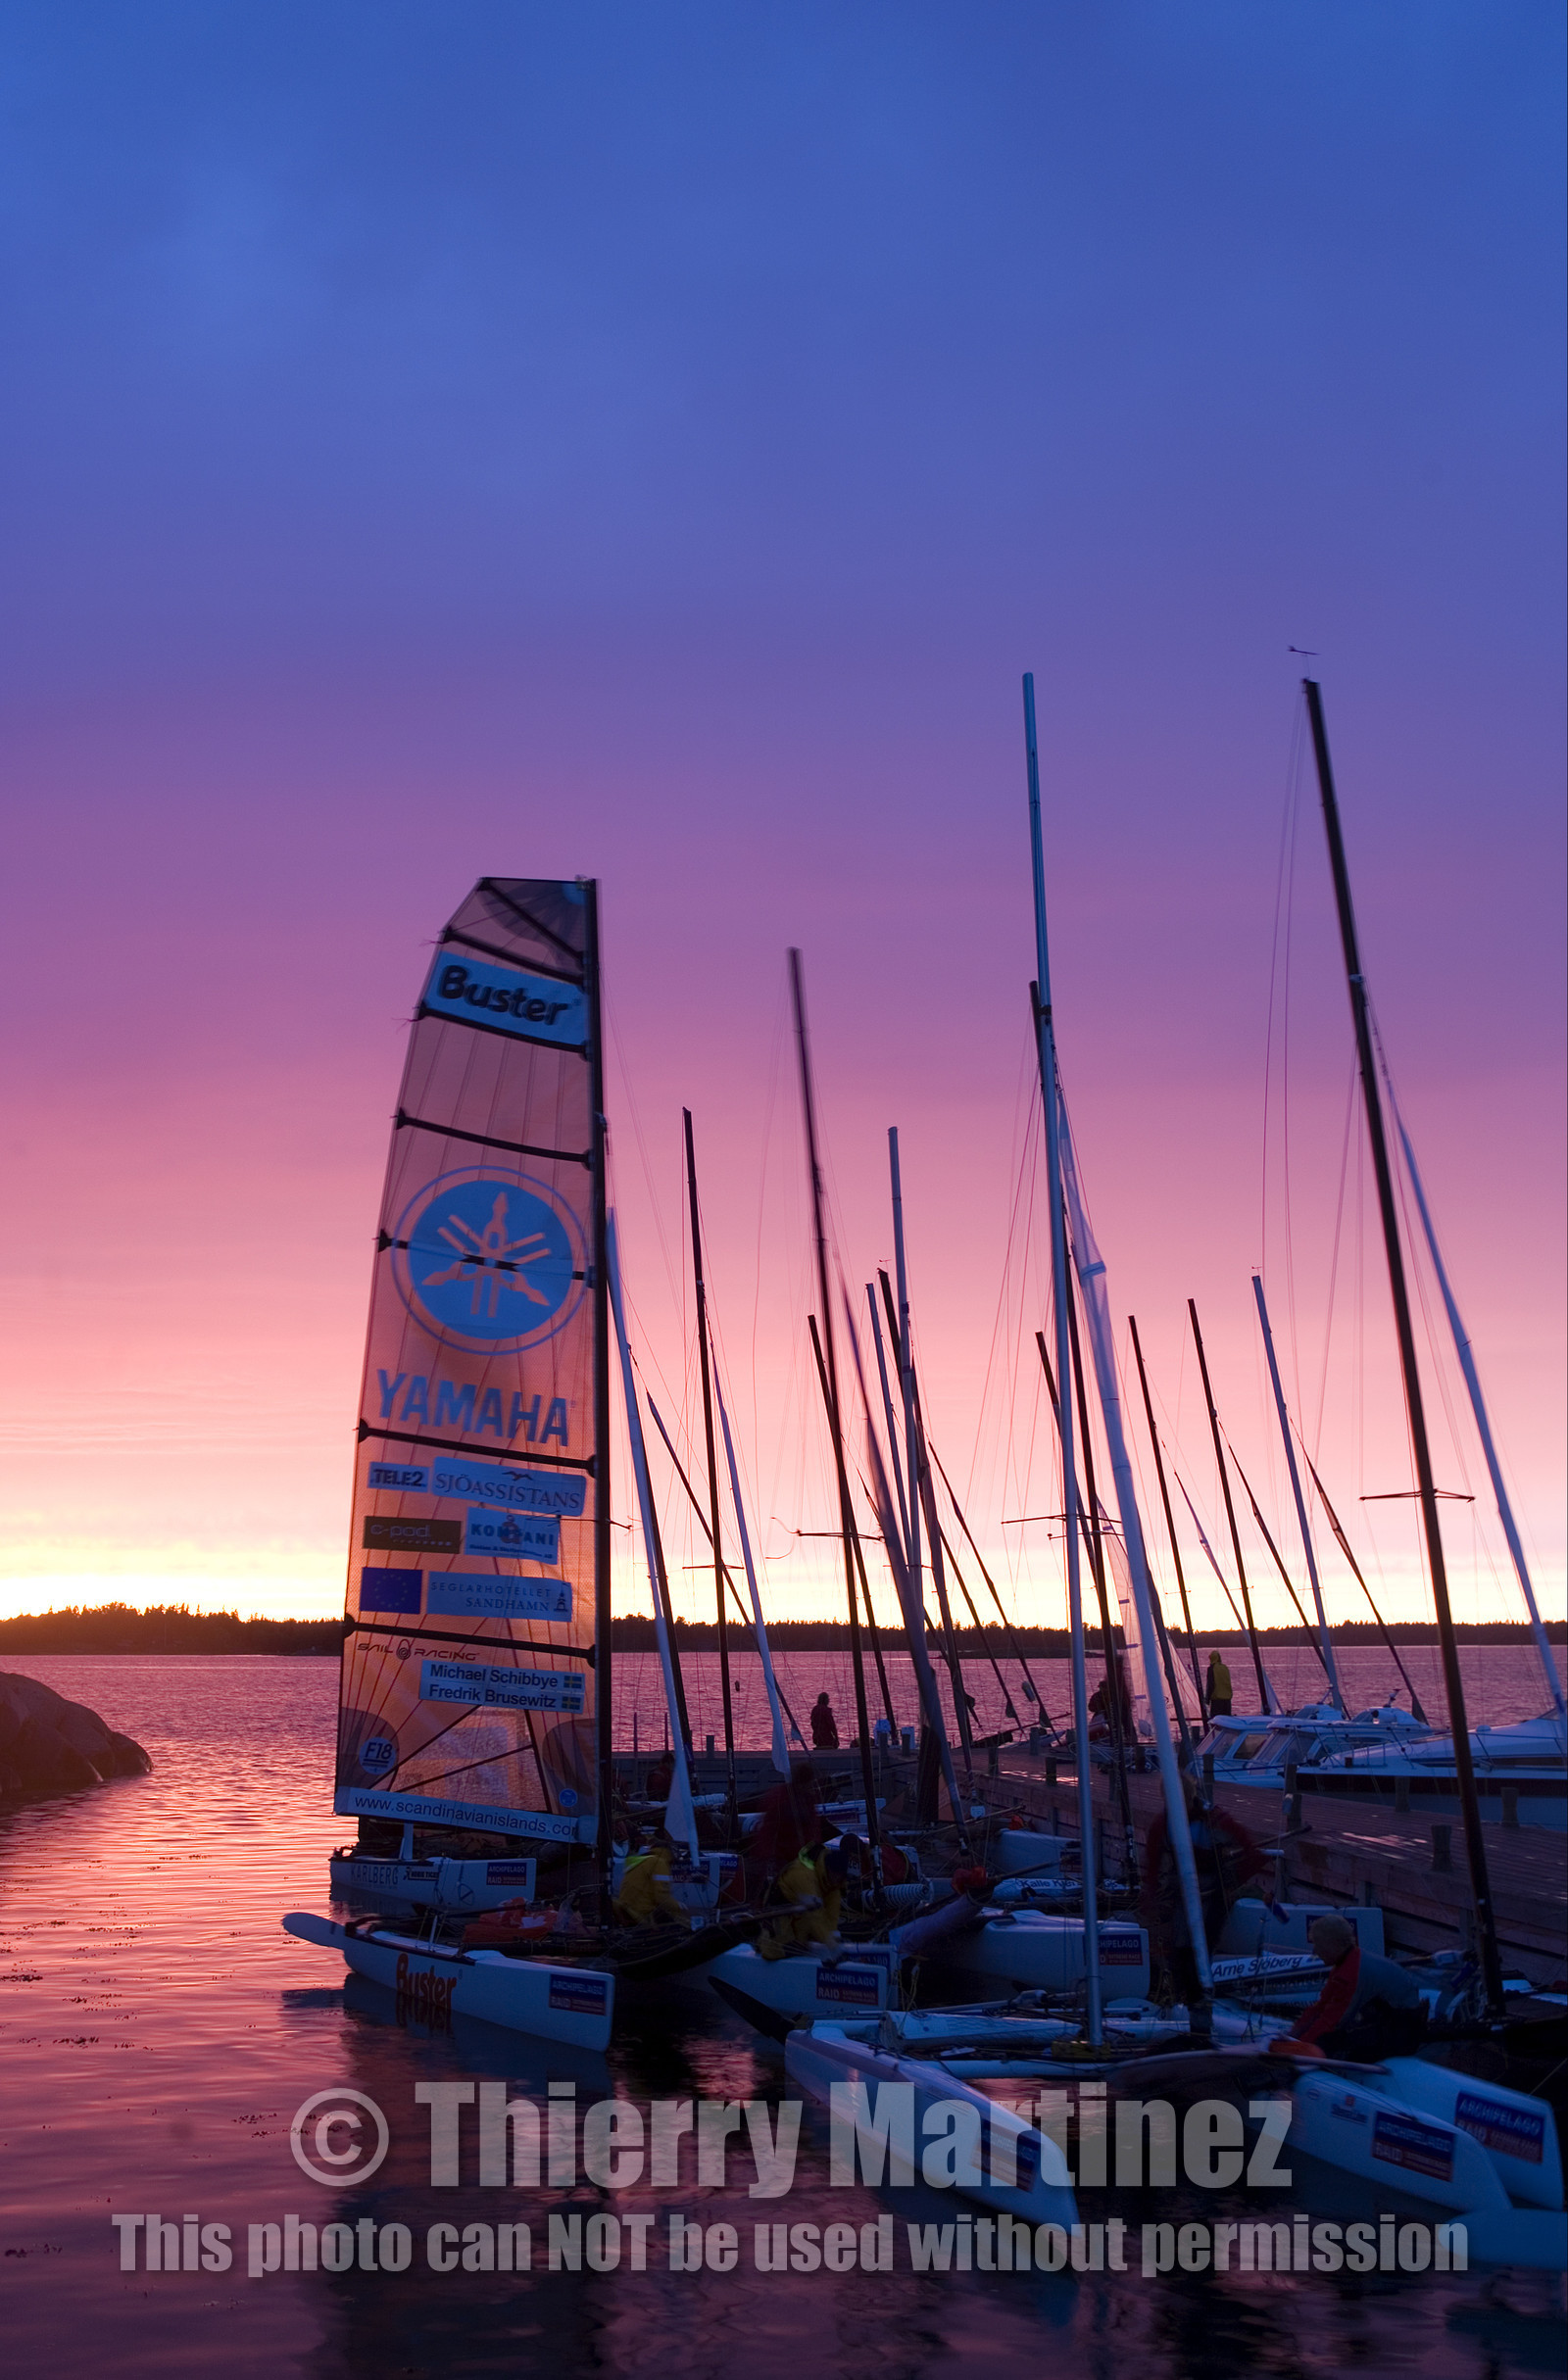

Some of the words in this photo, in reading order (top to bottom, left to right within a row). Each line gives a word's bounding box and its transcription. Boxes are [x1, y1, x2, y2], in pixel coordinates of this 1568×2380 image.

[440, 964, 569, 1026] Buster
[377, 1369, 568, 1447] YAMAHA
[372, 1468, 425, 1487] TELE2
[435, 1473, 581, 1510] SJÖASSISTANS
[430, 1581, 552, 1598] SEGLARHOTELLET
[466, 1597, 550, 1612] SANDHAMN
[357, 1642, 394, 1654] SAIL
[414, 1647, 477, 1661] RACING
[430, 1664, 487, 1682] Michael
[490, 1669, 559, 1689] Schibbye
[429, 1683, 481, 1702] Fredrik
[485, 1689, 557, 1708] Brusewitz
[365, 1742, 393, 1760] F18
[351, 1865, 399, 1885] KARLBERG
[488, 1865, 525, 1873] ARCHIPELAGO
[1099, 1939, 1139, 1948] HIPELAGO
[396, 1953, 457, 2008] Buster
[818, 1971, 876, 1987] ARCHIPELAGO
[817, 1986, 840, 1999] RAID
[1458, 2098, 1542, 2137] ARCHIPELAGO
